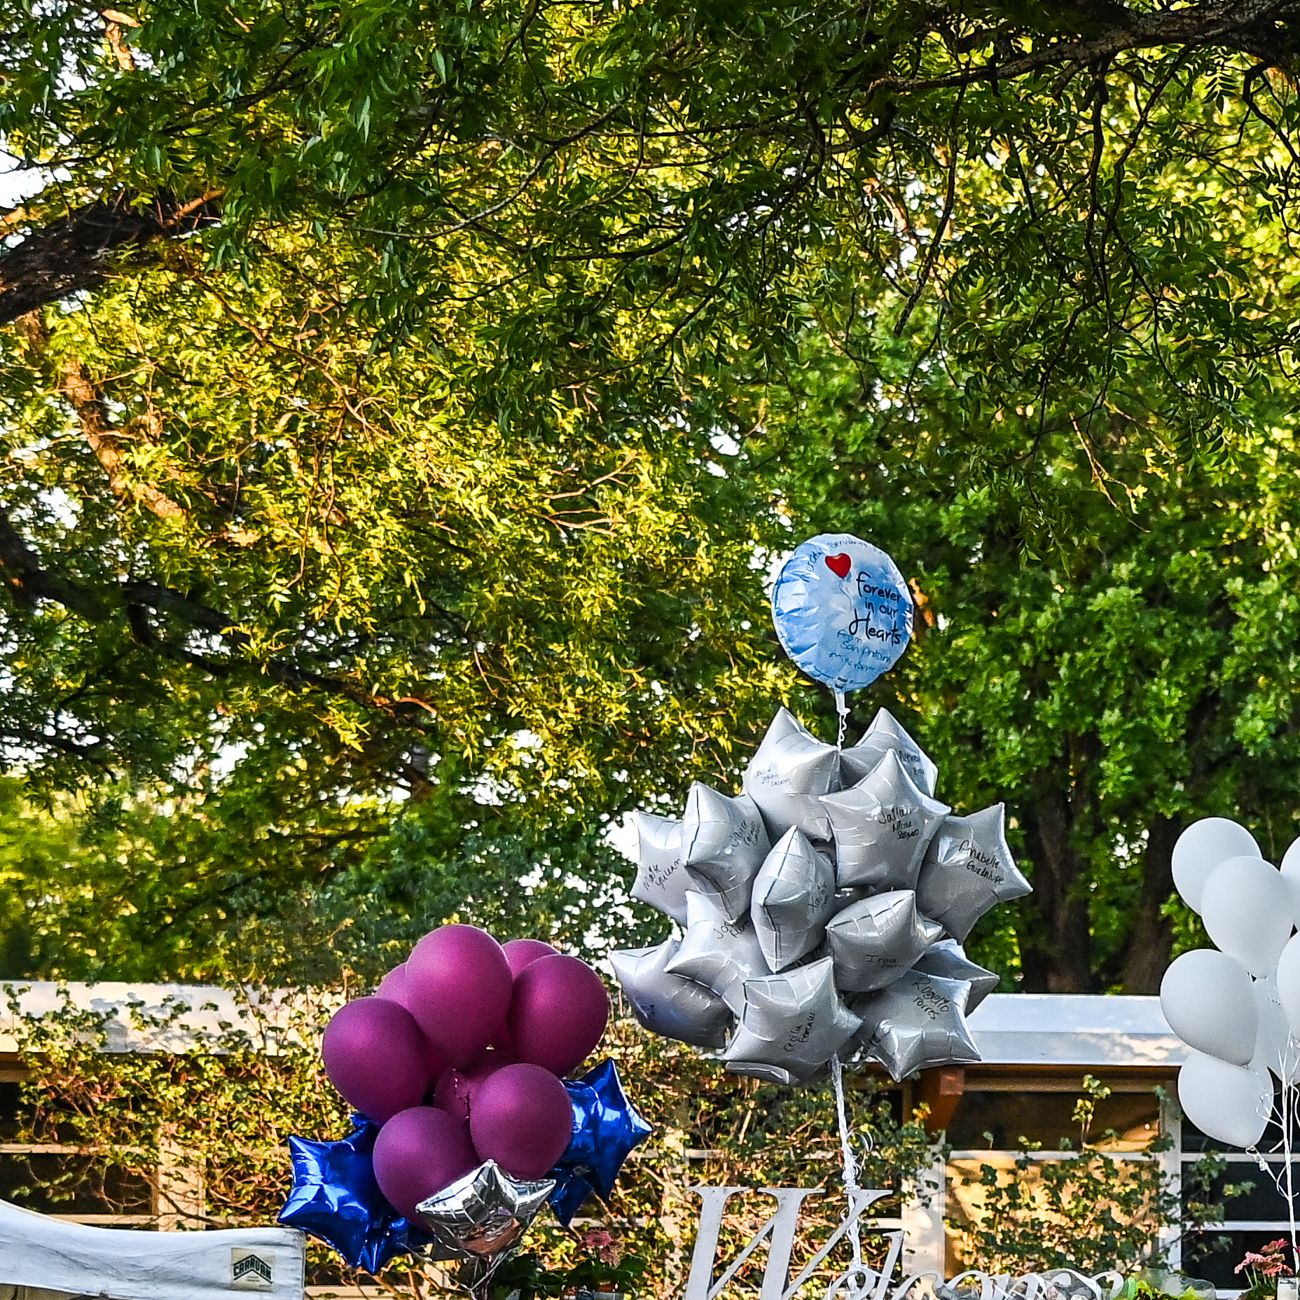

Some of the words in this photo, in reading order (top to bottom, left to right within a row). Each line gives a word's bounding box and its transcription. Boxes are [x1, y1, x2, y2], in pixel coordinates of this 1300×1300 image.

[864, 597, 875, 613] in
[878, 604, 898, 620] our
[849, 608, 902, 647] Hearts
